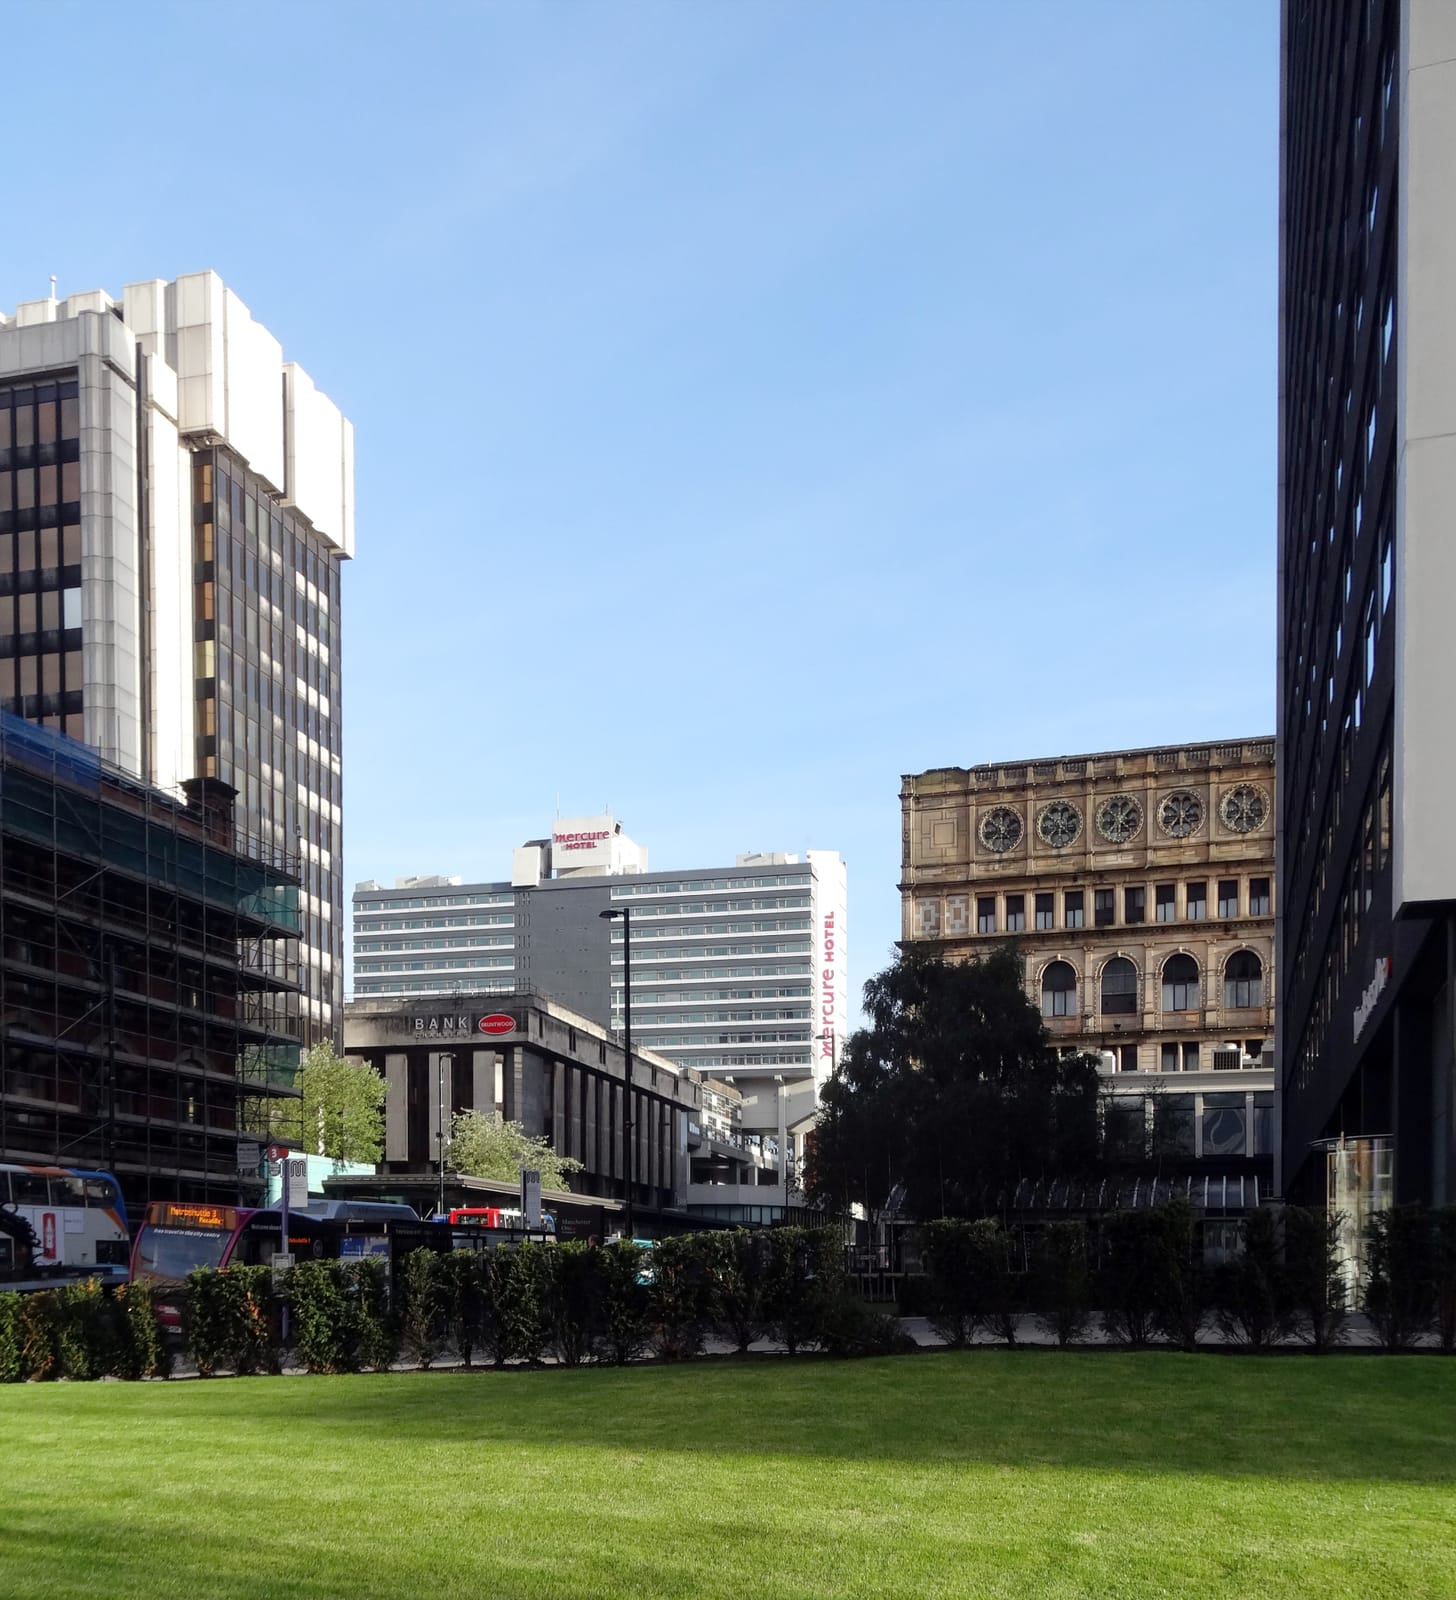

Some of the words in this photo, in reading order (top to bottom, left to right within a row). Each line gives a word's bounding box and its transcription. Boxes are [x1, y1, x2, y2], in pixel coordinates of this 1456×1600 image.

[564, 841, 598, 850] HOTEL
[824, 911, 835, 962] HOTEL
[415, 1016, 468, 1030] BANK
[271, 1148, 278, 1158] 3
